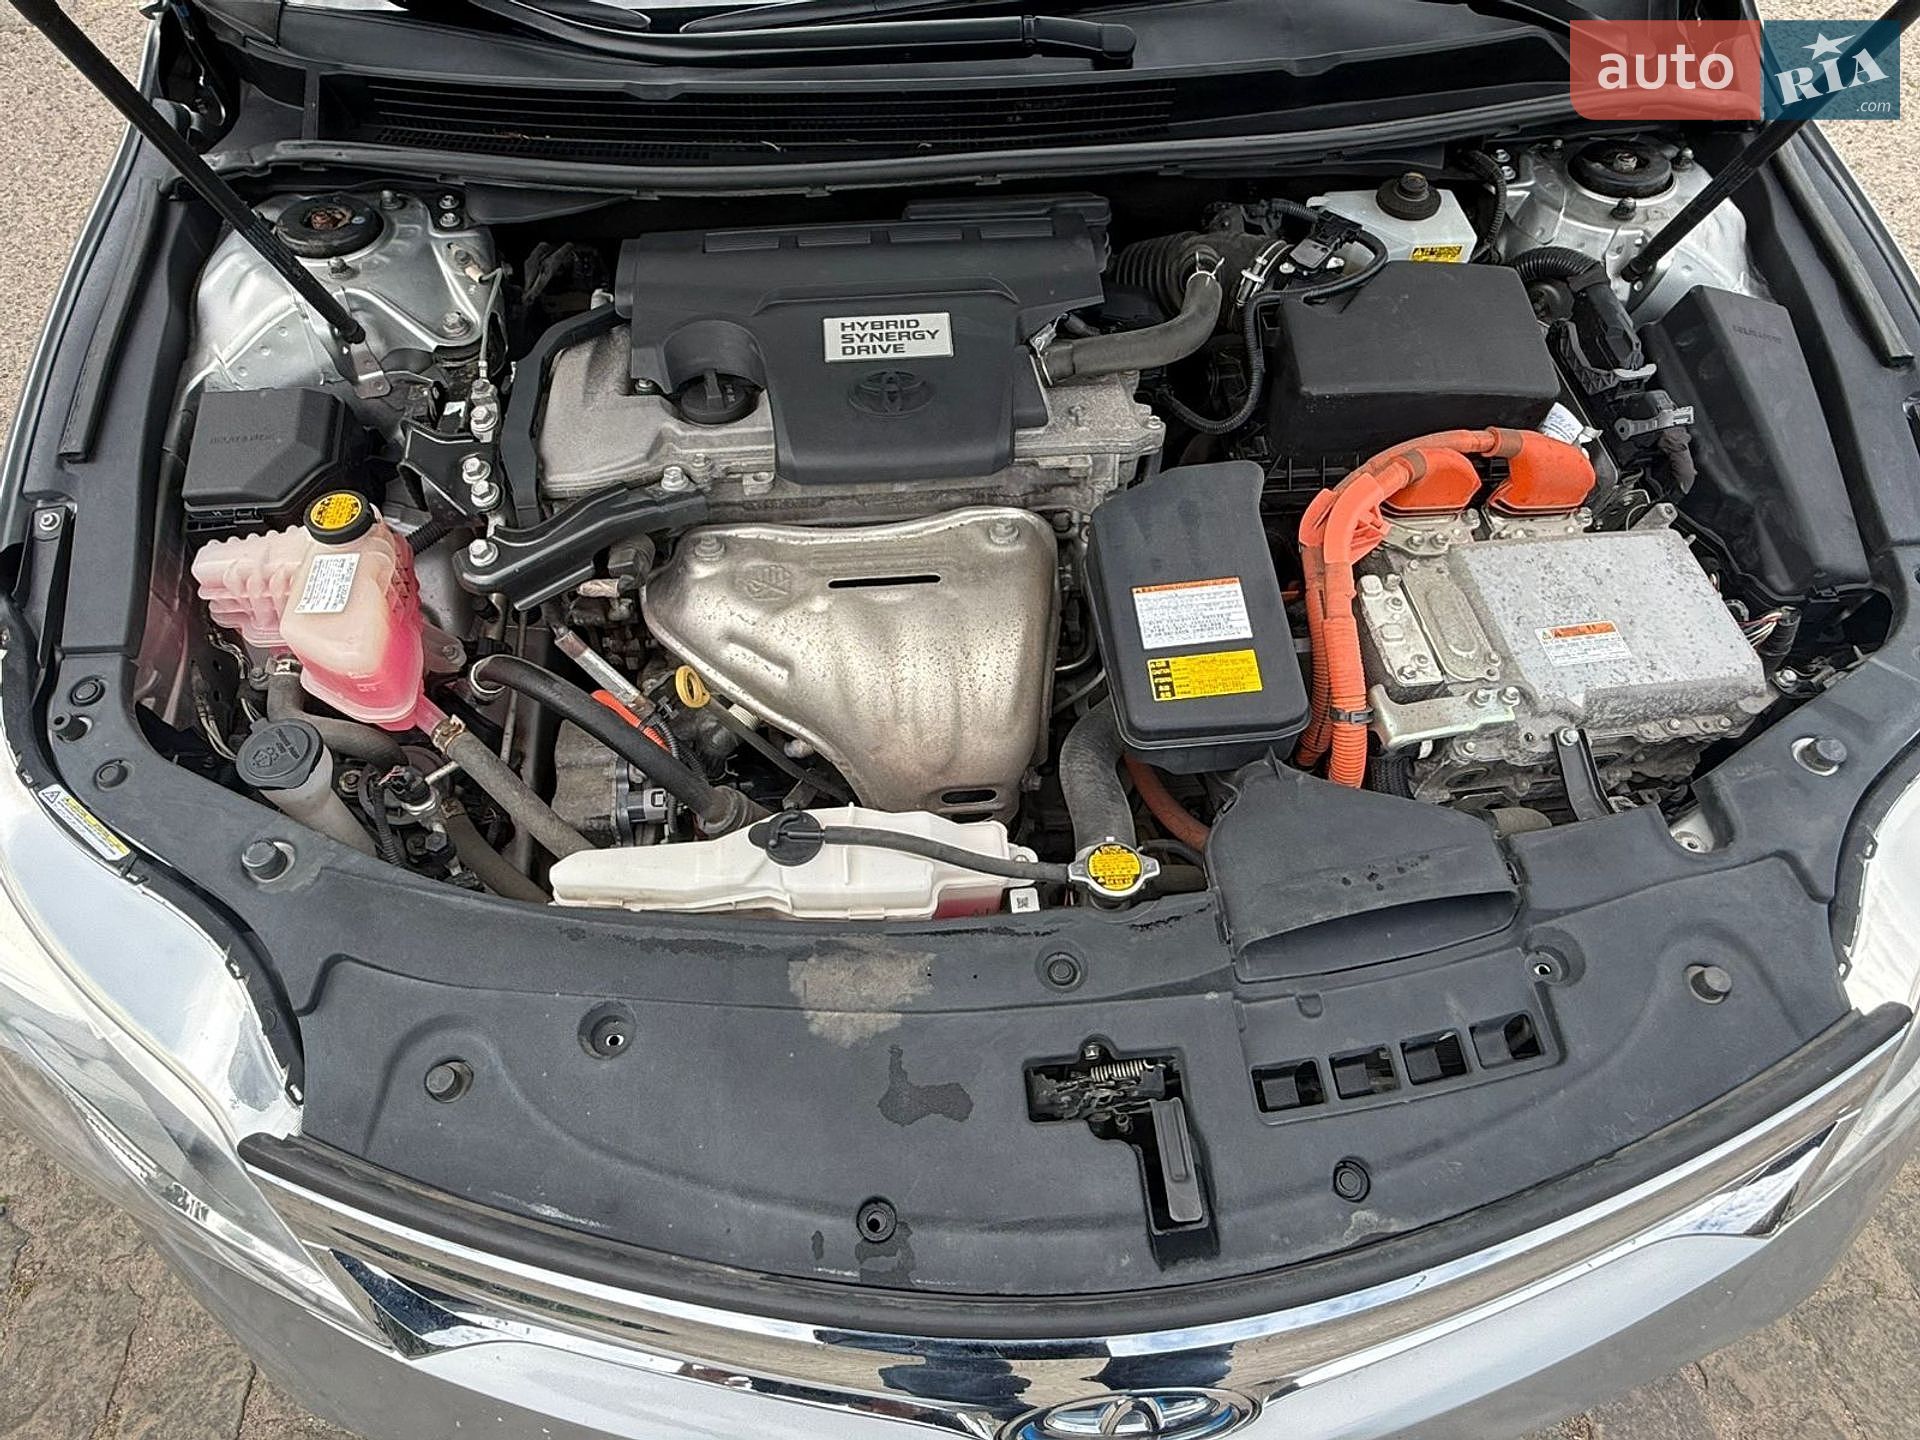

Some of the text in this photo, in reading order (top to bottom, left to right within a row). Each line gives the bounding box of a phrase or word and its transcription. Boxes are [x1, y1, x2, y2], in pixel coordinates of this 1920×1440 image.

[840, 319, 920, 332] HYBRID
[840, 329, 940, 344] SYNERGY
[841, 343, 906, 356] DRIVE
